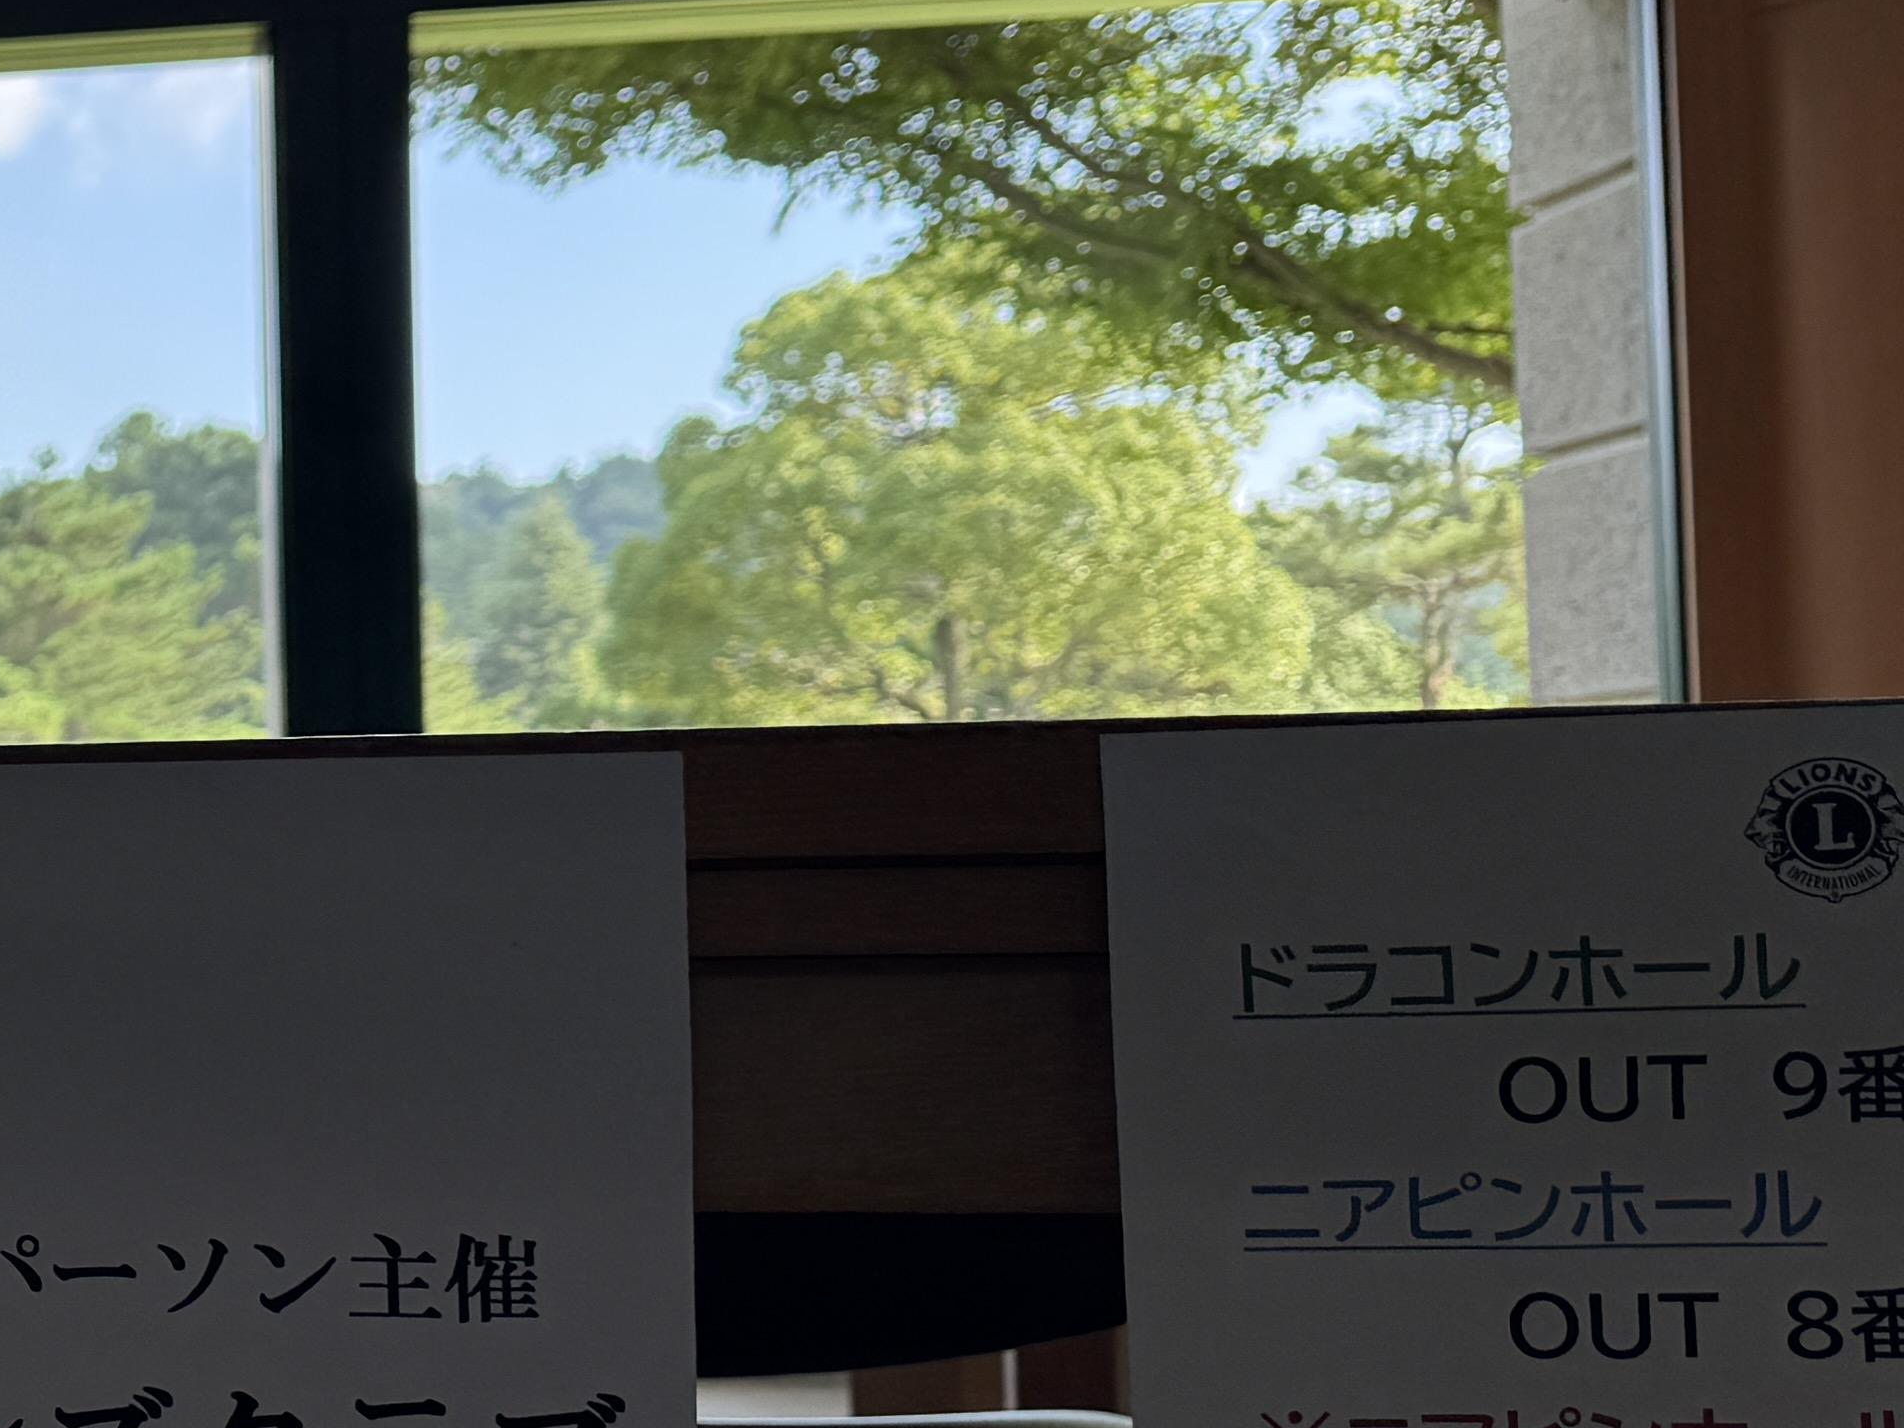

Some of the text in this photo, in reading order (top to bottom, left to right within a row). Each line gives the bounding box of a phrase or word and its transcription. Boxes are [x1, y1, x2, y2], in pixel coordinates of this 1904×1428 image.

[1779, 763, 1877, 794] LIONS
[1812, 803, 1856, 850] L
[1787, 865, 1881, 890] INTERNATIONAL
[1241, 933, 1801, 1013] ドラコンホール
[1499, 1053, 1708, 1124] OUT
[1245, 1170, 1823, 1243] ニアピンホール
[1510, 1291, 1720, 1360] OUT
